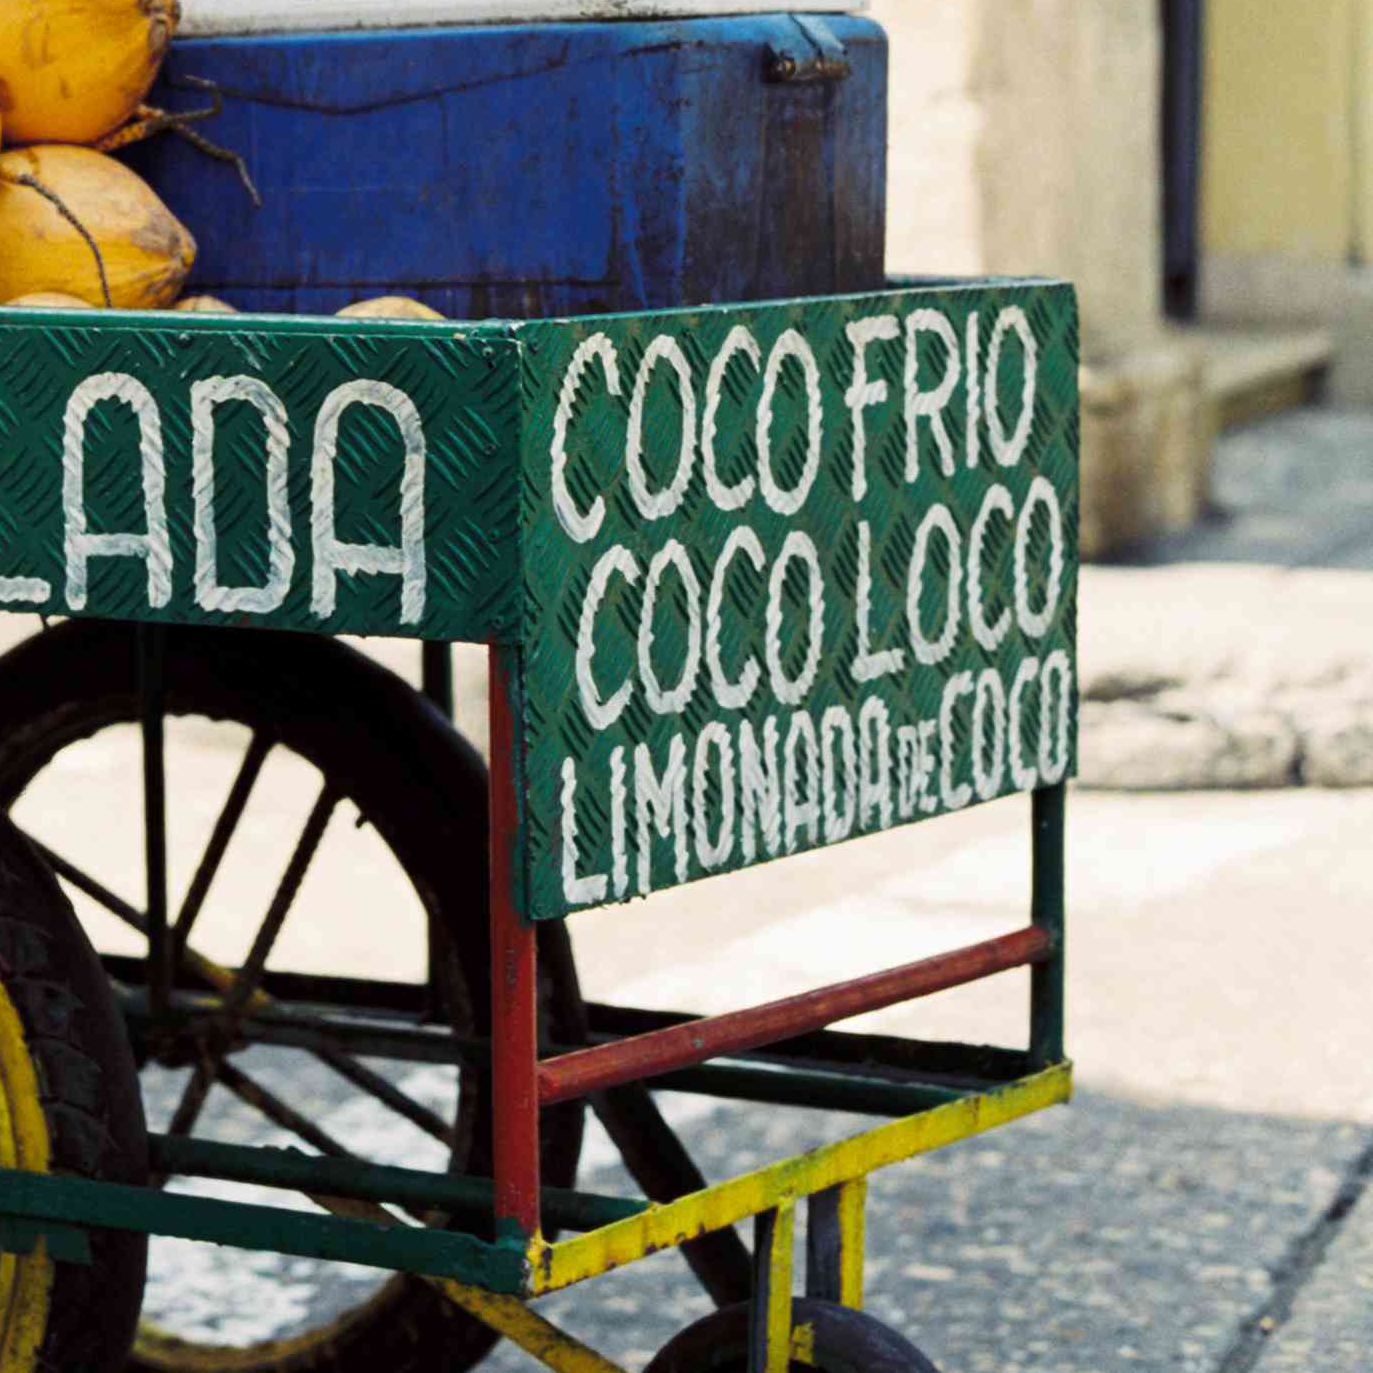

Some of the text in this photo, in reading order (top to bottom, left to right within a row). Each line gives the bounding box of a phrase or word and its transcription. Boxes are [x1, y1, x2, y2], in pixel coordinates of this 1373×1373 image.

[551, 305, 1038, 544] COCO FRIO
[575, 475, 1065, 731] COCO LOCO
[561, 649, 1072, 906] LIMONADA DE COCO
